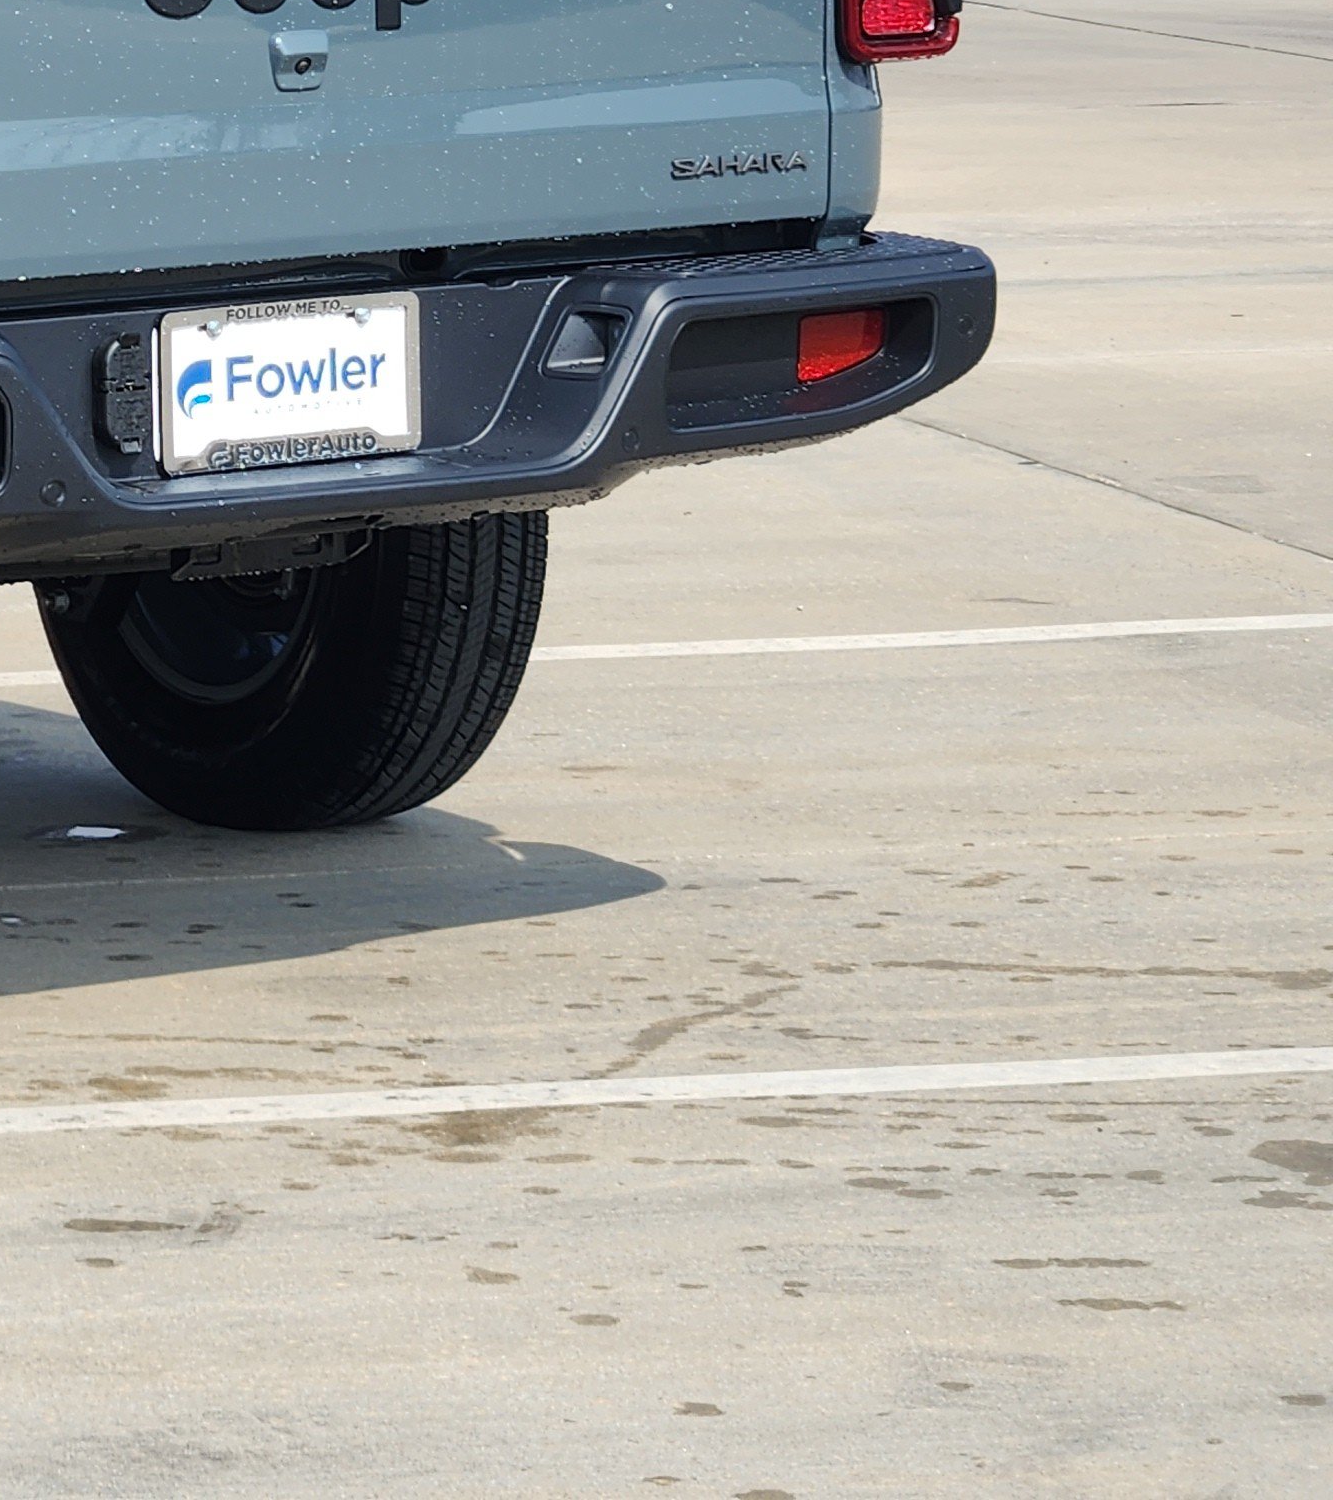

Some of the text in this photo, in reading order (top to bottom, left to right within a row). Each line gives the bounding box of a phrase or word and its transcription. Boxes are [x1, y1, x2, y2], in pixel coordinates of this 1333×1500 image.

[671, 150, 808, 181] SAHARA
[226, 303, 291, 321] FOLLOW
[295, 301, 316, 315] ME
[226, 347, 386, 402] Fowler
